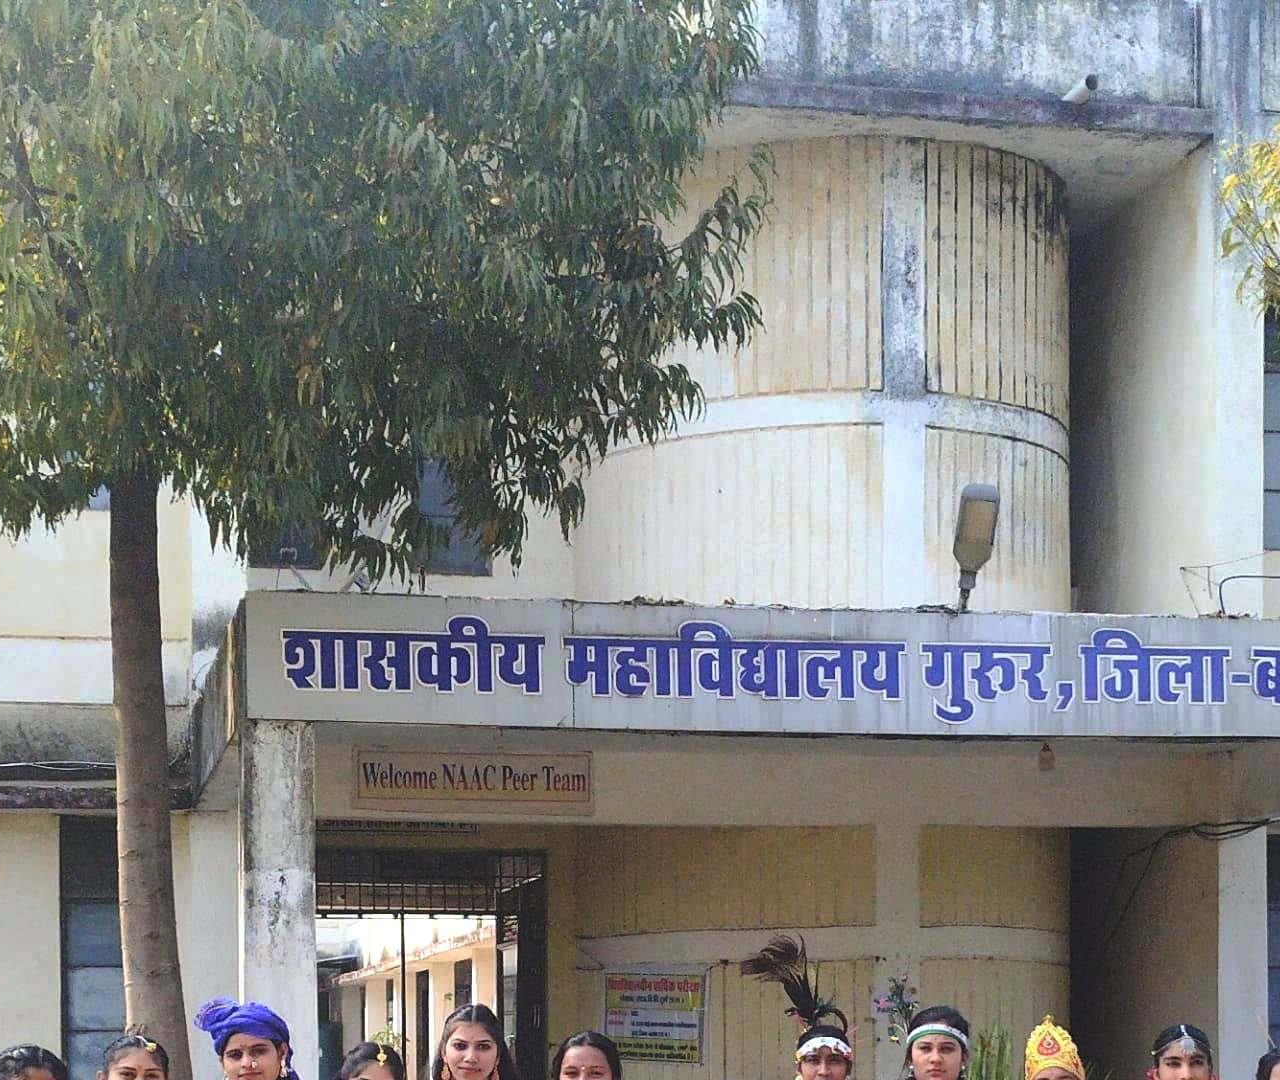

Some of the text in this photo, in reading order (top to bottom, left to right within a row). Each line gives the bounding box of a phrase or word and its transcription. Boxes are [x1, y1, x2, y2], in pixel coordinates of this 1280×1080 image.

[282, 616, 544, 694] शासकीय
[563, 621, 906, 699] महाविद्यालय
[362, 762, 586, 793] Welcome NAAC Peer Team
